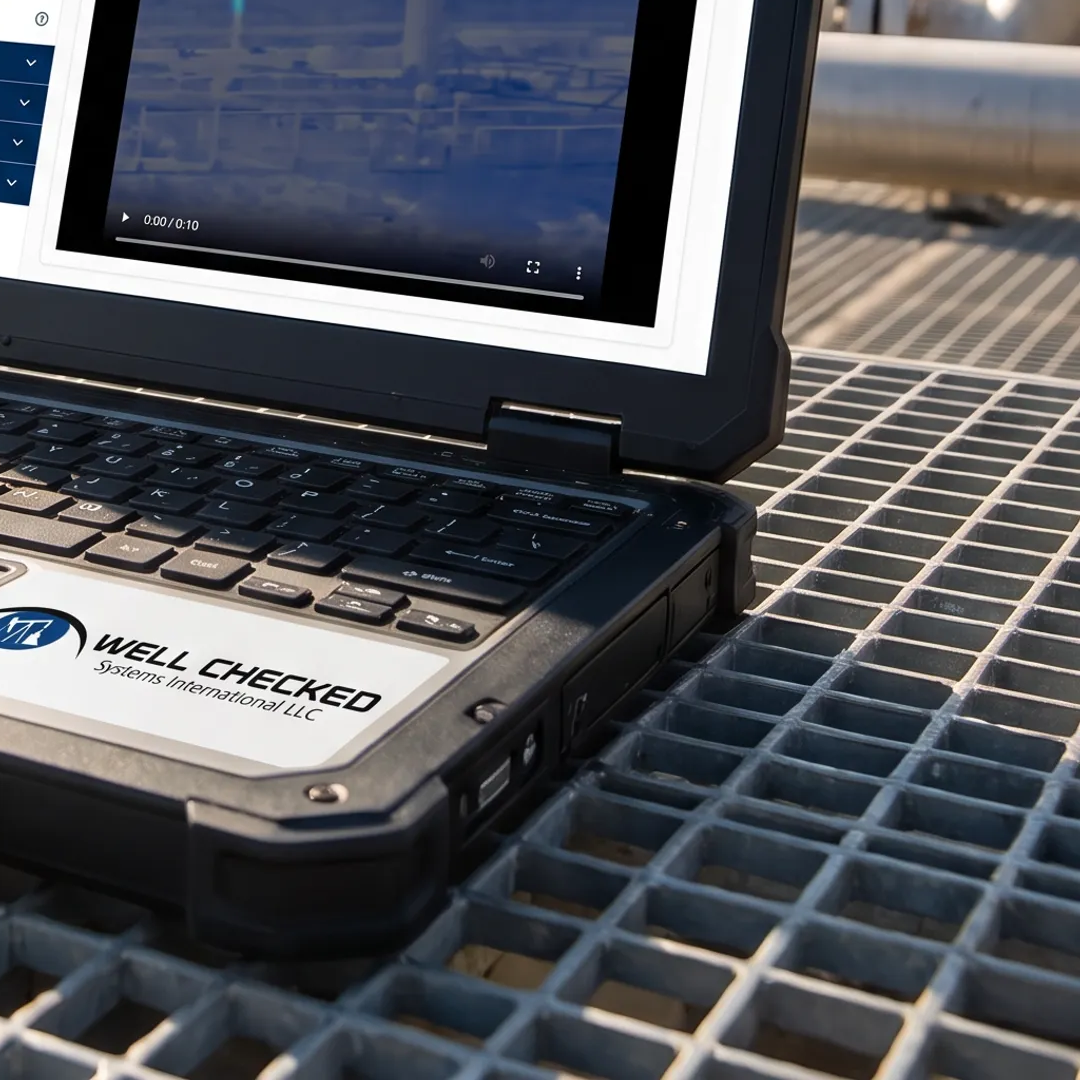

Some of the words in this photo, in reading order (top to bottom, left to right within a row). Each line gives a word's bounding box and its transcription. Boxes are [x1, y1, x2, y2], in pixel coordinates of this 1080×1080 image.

[143, 214, 167, 227] 0:00
[175, 218, 199, 231] 0:10
[92, 633, 190, 672] WELL
[198, 658, 382, 713] CHECKED
[93, 660, 166, 685] Systems
[166, 675, 286, 712] International
[283, 703, 323, 722] LLC
